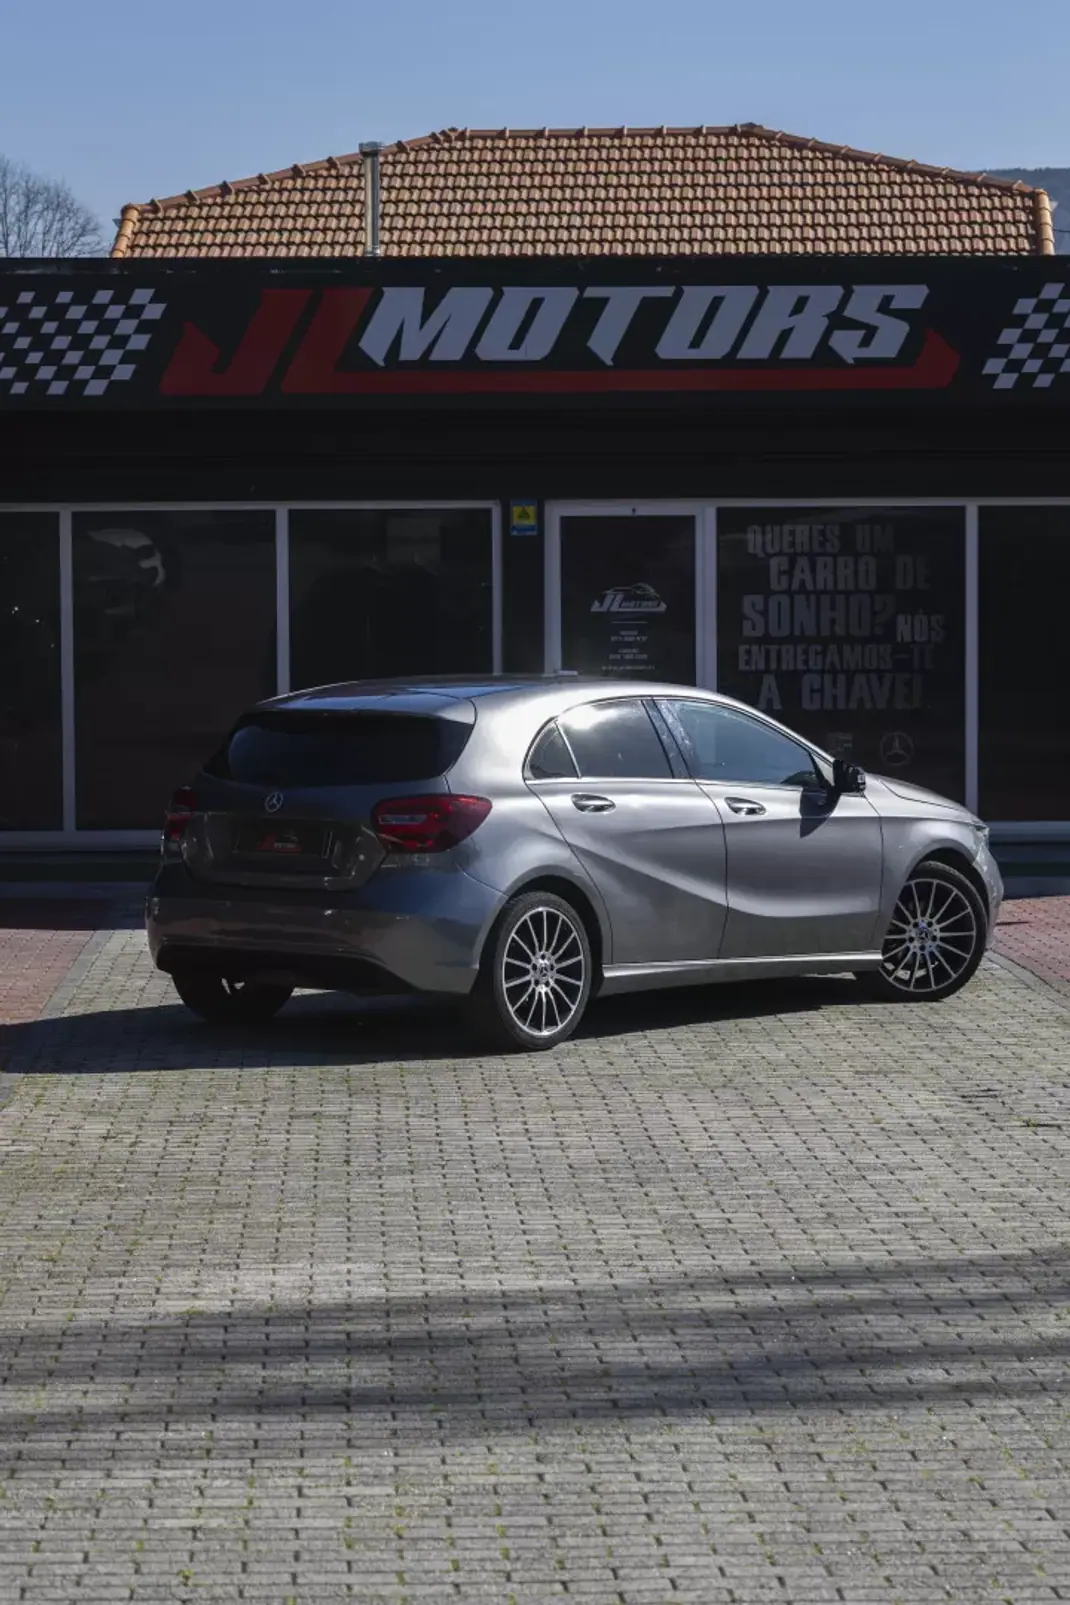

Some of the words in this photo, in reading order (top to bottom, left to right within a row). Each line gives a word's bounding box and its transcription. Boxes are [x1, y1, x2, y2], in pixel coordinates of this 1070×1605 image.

[359, 284, 930, 368] MOTORS
[747, 524, 841, 557] QUERES
[854, 524, 895, 554] UM
[769, 555, 878, 592] CARRO
[895, 555, 932, 590] DE
[742, 593, 897, 638] SONHO?
[757, 673, 783, 710] A
